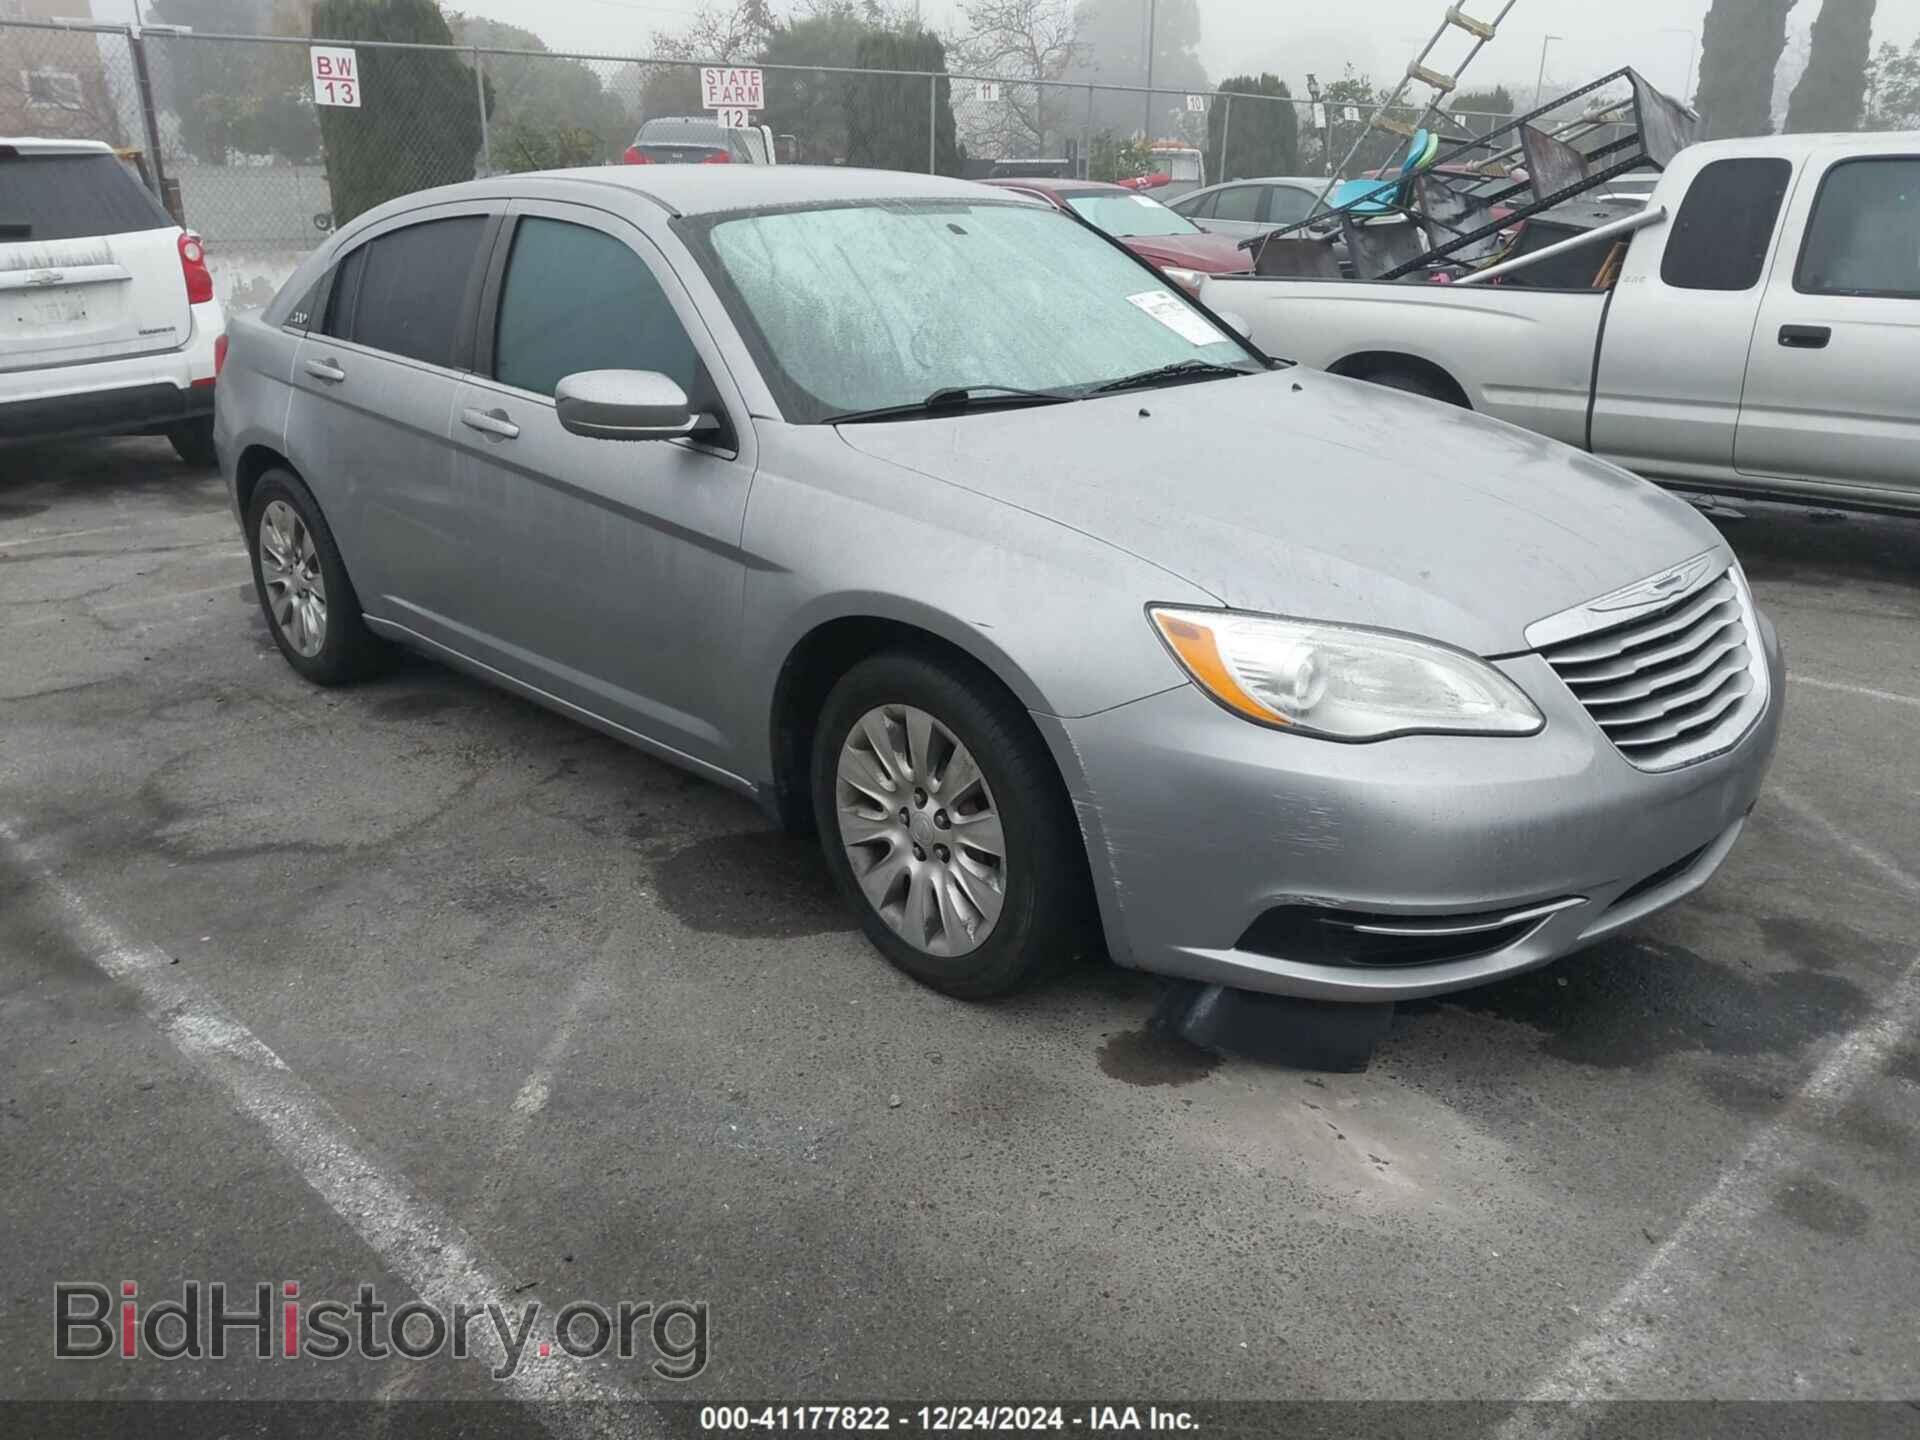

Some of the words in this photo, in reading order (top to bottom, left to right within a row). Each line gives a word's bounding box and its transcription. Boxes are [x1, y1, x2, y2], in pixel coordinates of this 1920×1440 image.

[316, 56, 352, 76] BW
[706, 69, 760, 86] STATE
[324, 82, 354, 104] 13
[709, 86, 760, 102] FARM
[981, 83, 992, 99] 11
[723, 110, 744, 127] 12
